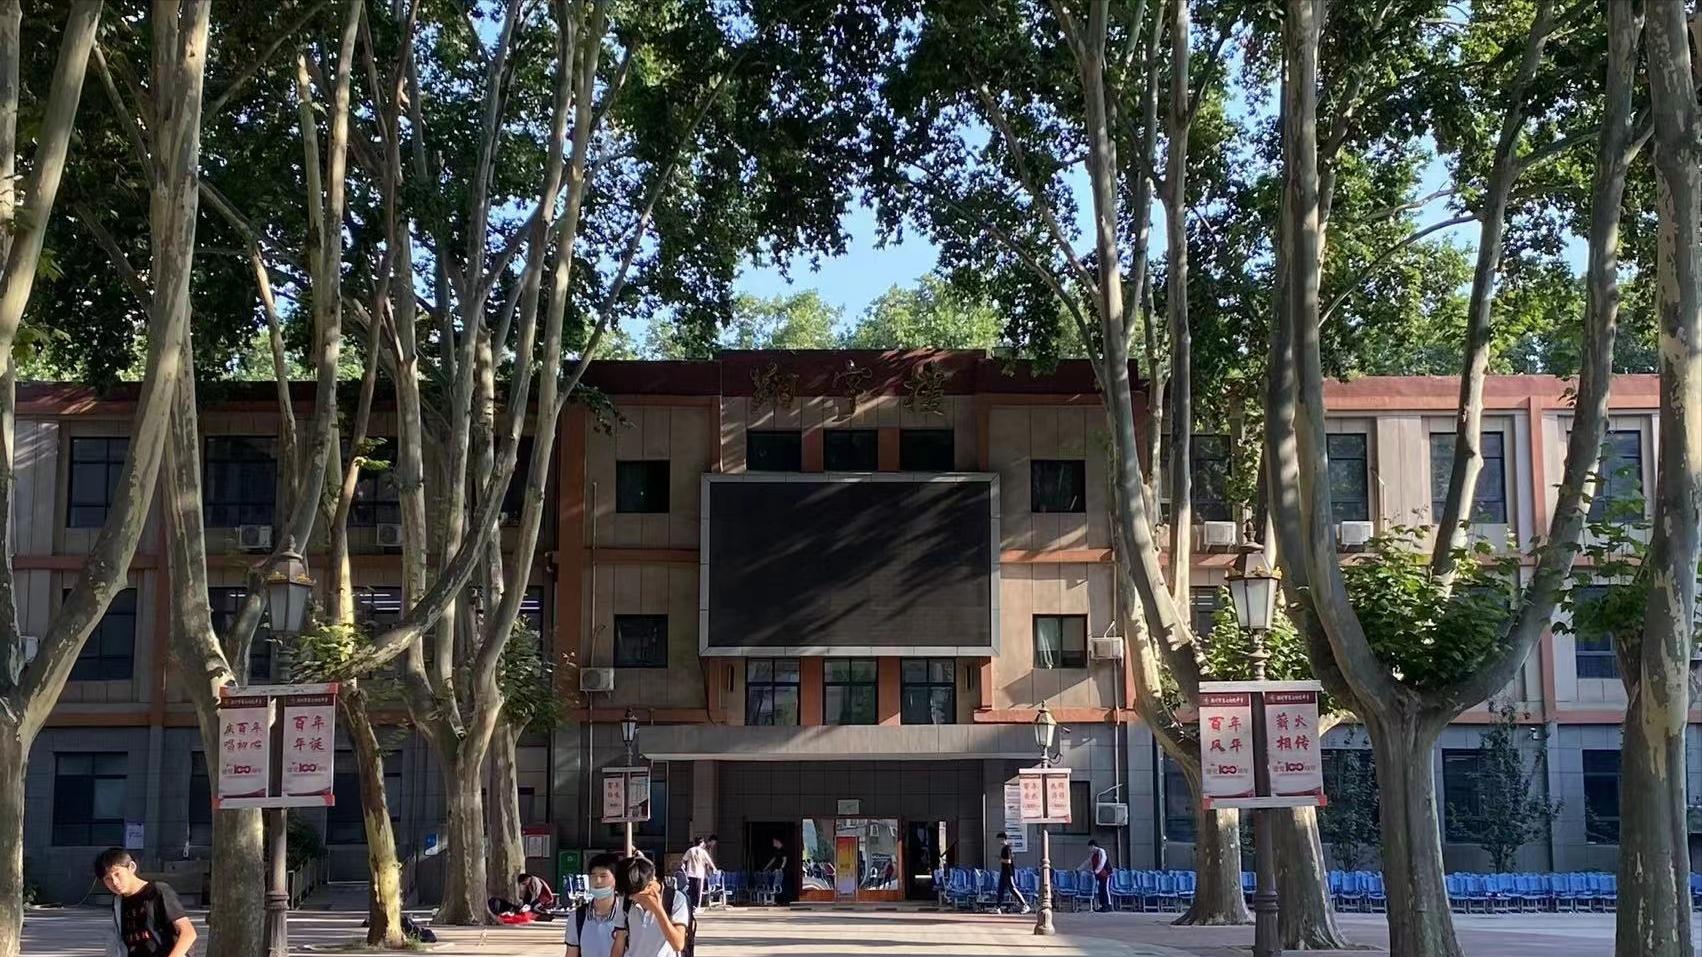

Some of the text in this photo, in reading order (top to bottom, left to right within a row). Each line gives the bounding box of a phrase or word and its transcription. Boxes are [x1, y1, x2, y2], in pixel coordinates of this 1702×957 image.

[224, 722, 261, 735] 庆百年
[292, 715, 324, 731] 百年
[1208, 716, 1241, 732] 百年
[1276, 735, 1309, 751] 相传
